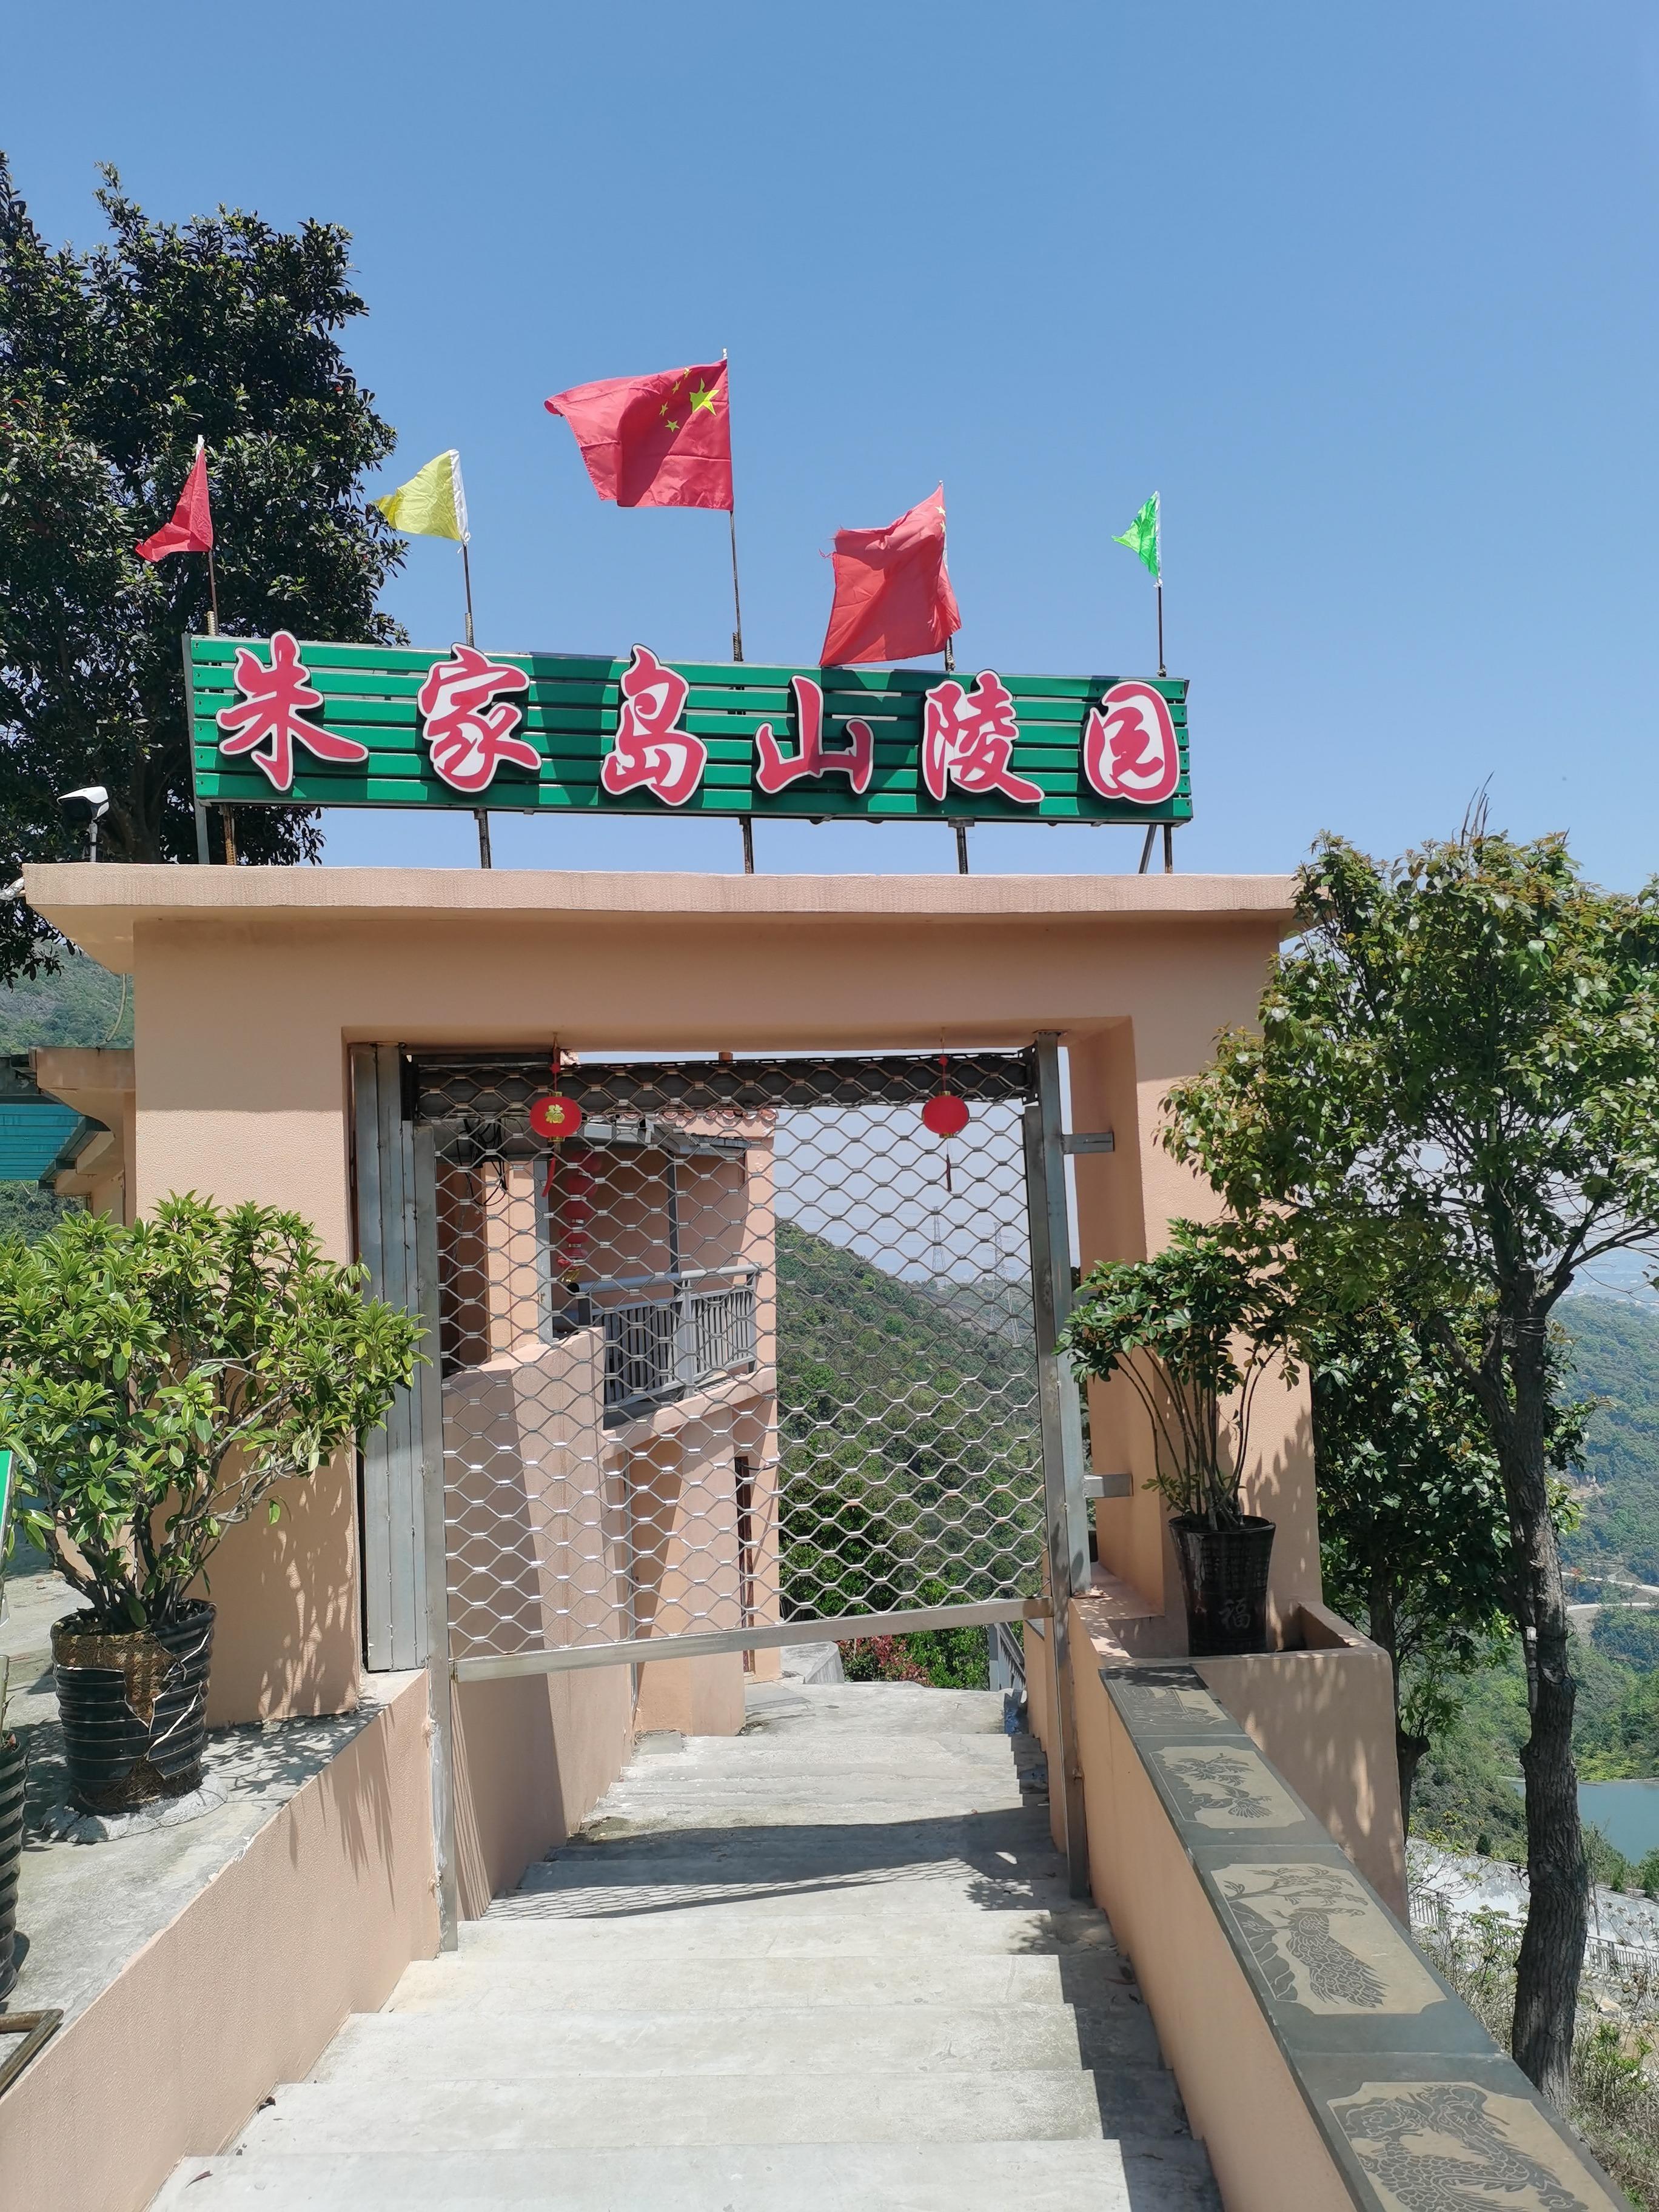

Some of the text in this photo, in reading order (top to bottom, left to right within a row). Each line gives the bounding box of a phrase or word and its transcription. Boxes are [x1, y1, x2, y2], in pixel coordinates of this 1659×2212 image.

[216, 630, 1180, 806] 朱家岛山陵园
[545, 1104, 565, 1124] 福
[1218, 1598, 1251, 1630] 福
